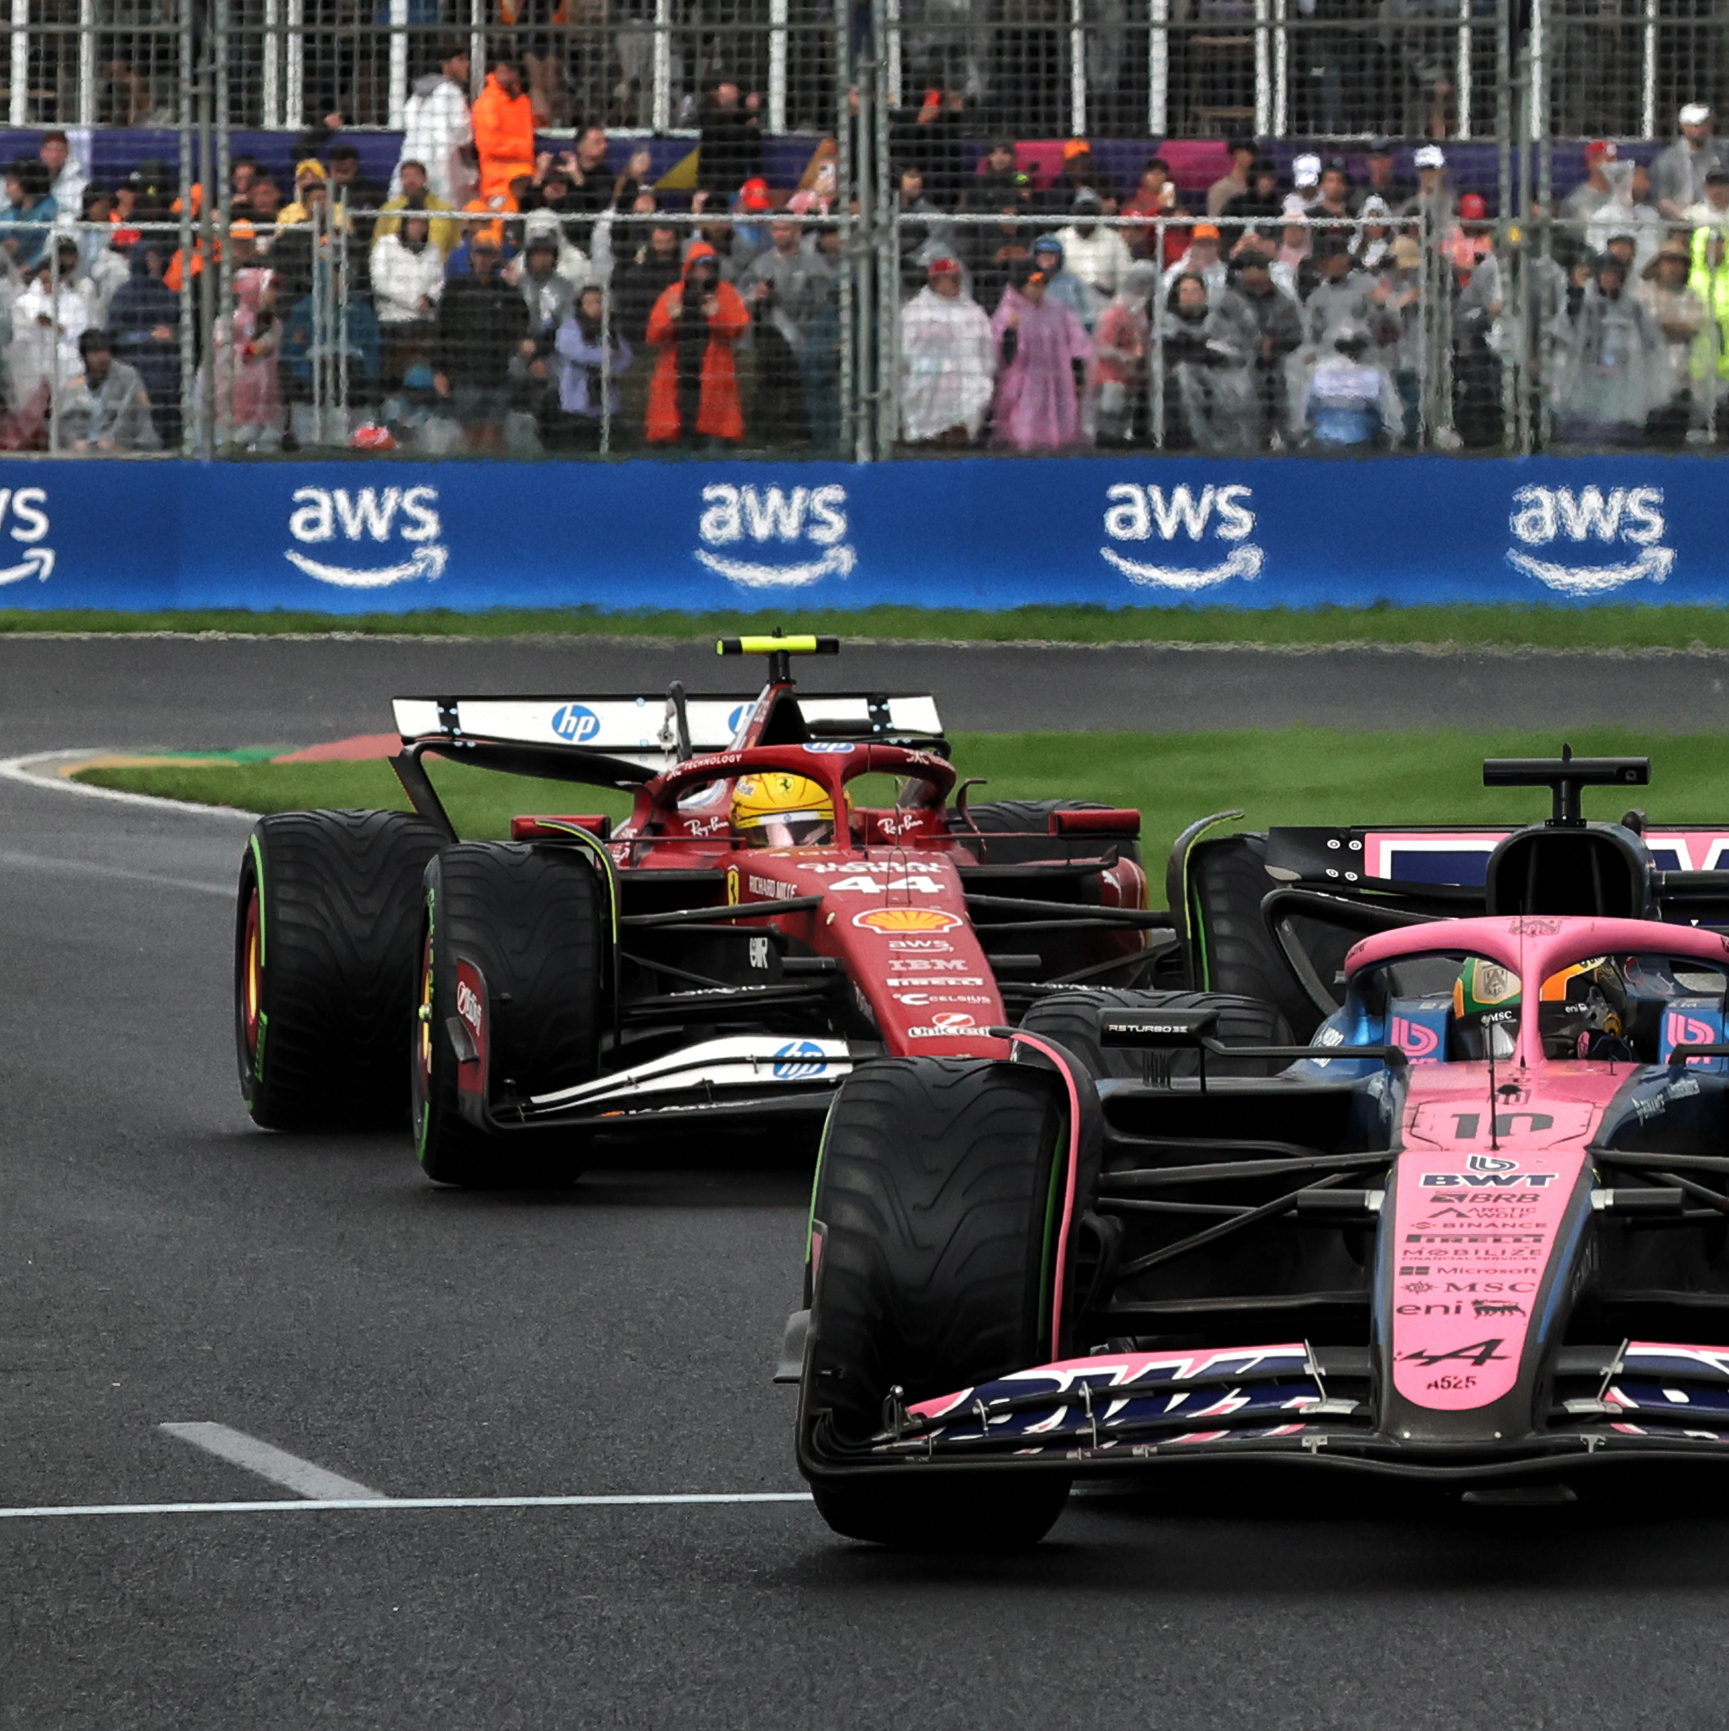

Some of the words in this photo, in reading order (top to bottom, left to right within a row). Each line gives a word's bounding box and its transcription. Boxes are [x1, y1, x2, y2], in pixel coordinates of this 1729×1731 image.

[290, 487, 440, 541] aws
[700, 484, 846, 542] aws
[1105, 484, 1255, 541] aws
[1511, 486, 1665, 545] aws
[556, 705, 597, 741] hp
[685, 753, 742, 771] TECHNOLOGY
[748, 875, 775, 898] RICHARD
[829, 876, 945, 893] 44
[888, 940, 950, 948] aws
[888, 959, 969, 970] IBM
[1565, 1004, 1579, 1013] eni
[1491, 1011, 1512, 1022] MSC
[1419, 1173, 1559, 1187] BWT
[1468, 1193, 1541, 1203] BRB
[1405, 1233, 1545, 1243] PIRELLI
[1437, 1267, 1538, 1275] Microsoft
[1444, 1282, 1536, 1293] MSC
[1396, 1301, 1463, 1316] eni
